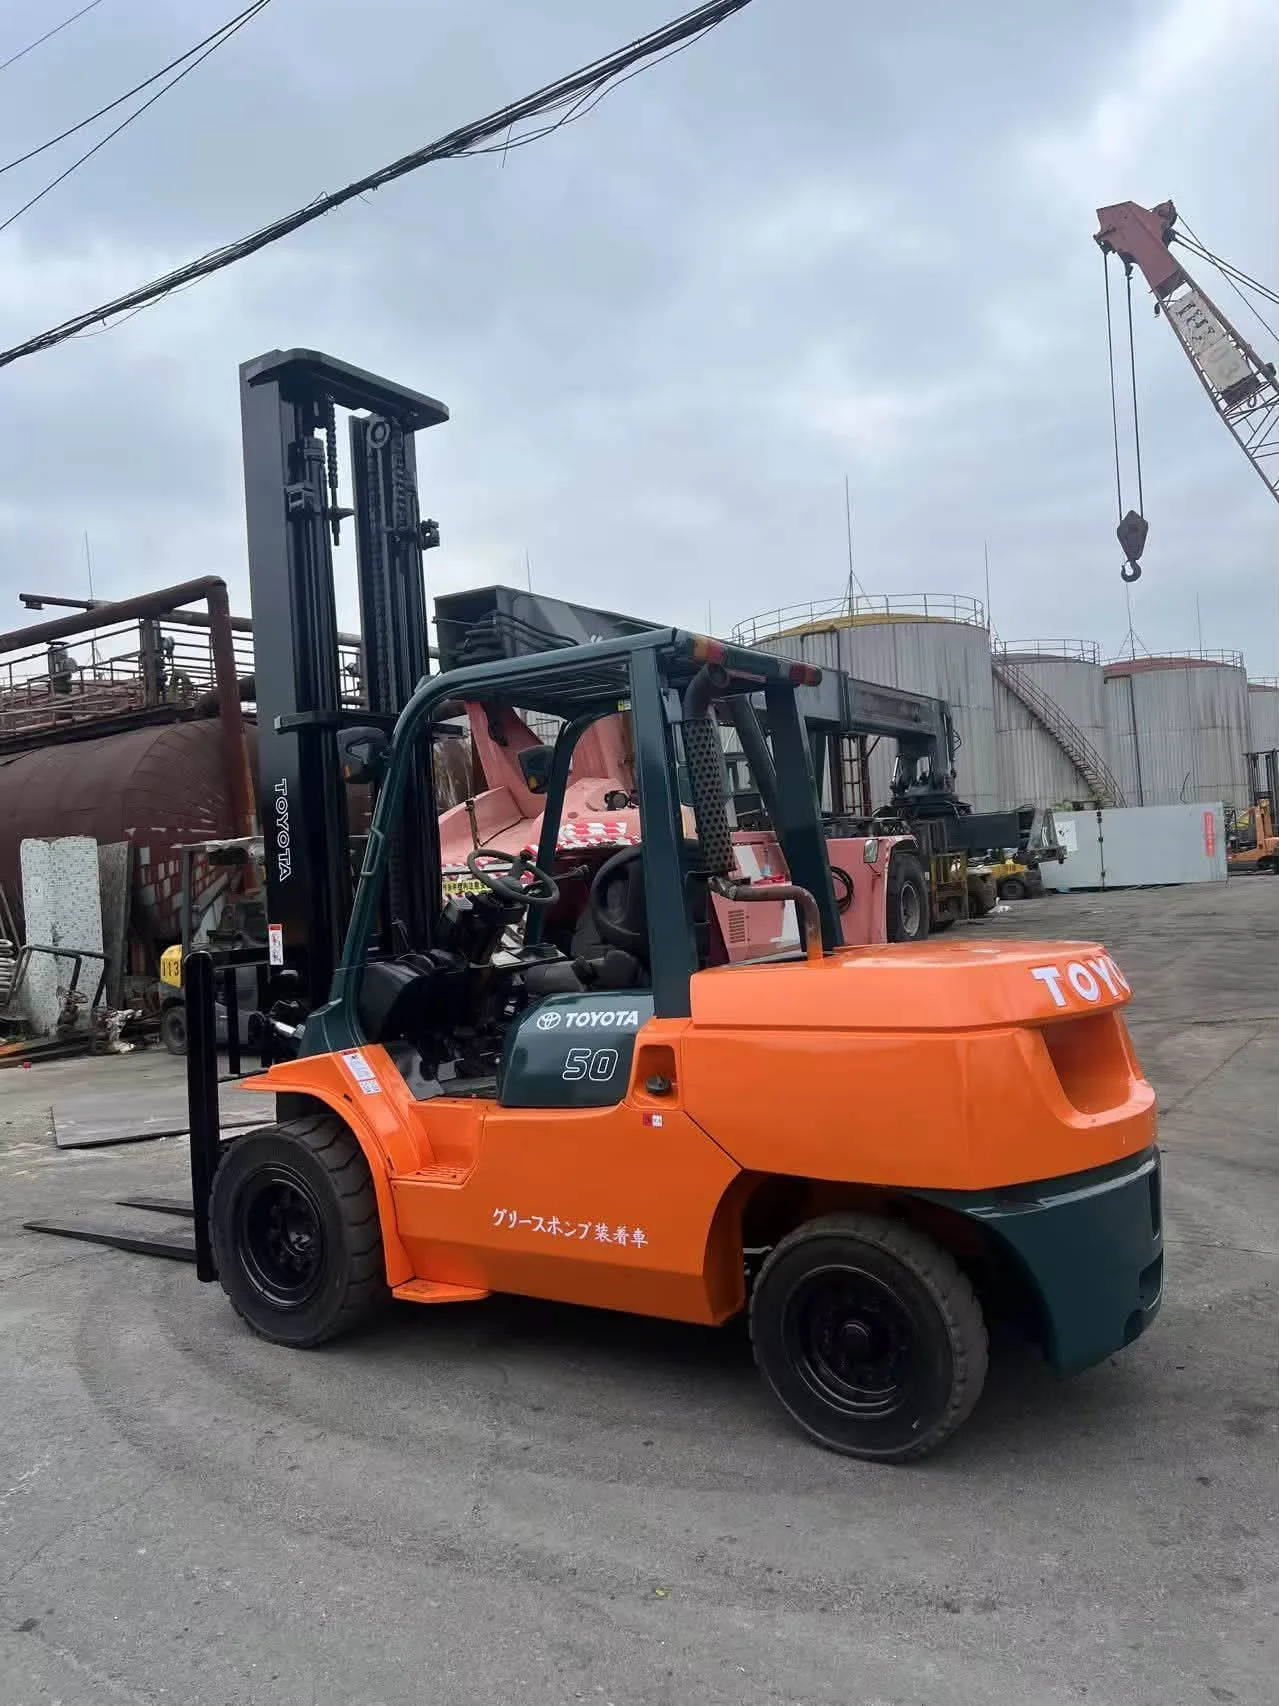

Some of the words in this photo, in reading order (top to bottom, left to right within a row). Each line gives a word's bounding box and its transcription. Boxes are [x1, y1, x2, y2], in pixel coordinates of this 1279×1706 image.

[274, 778, 292, 882] TOYOTA
[565, 1010, 639, 1028] TOYOTA
[562, 1047, 619, 1082] 50
